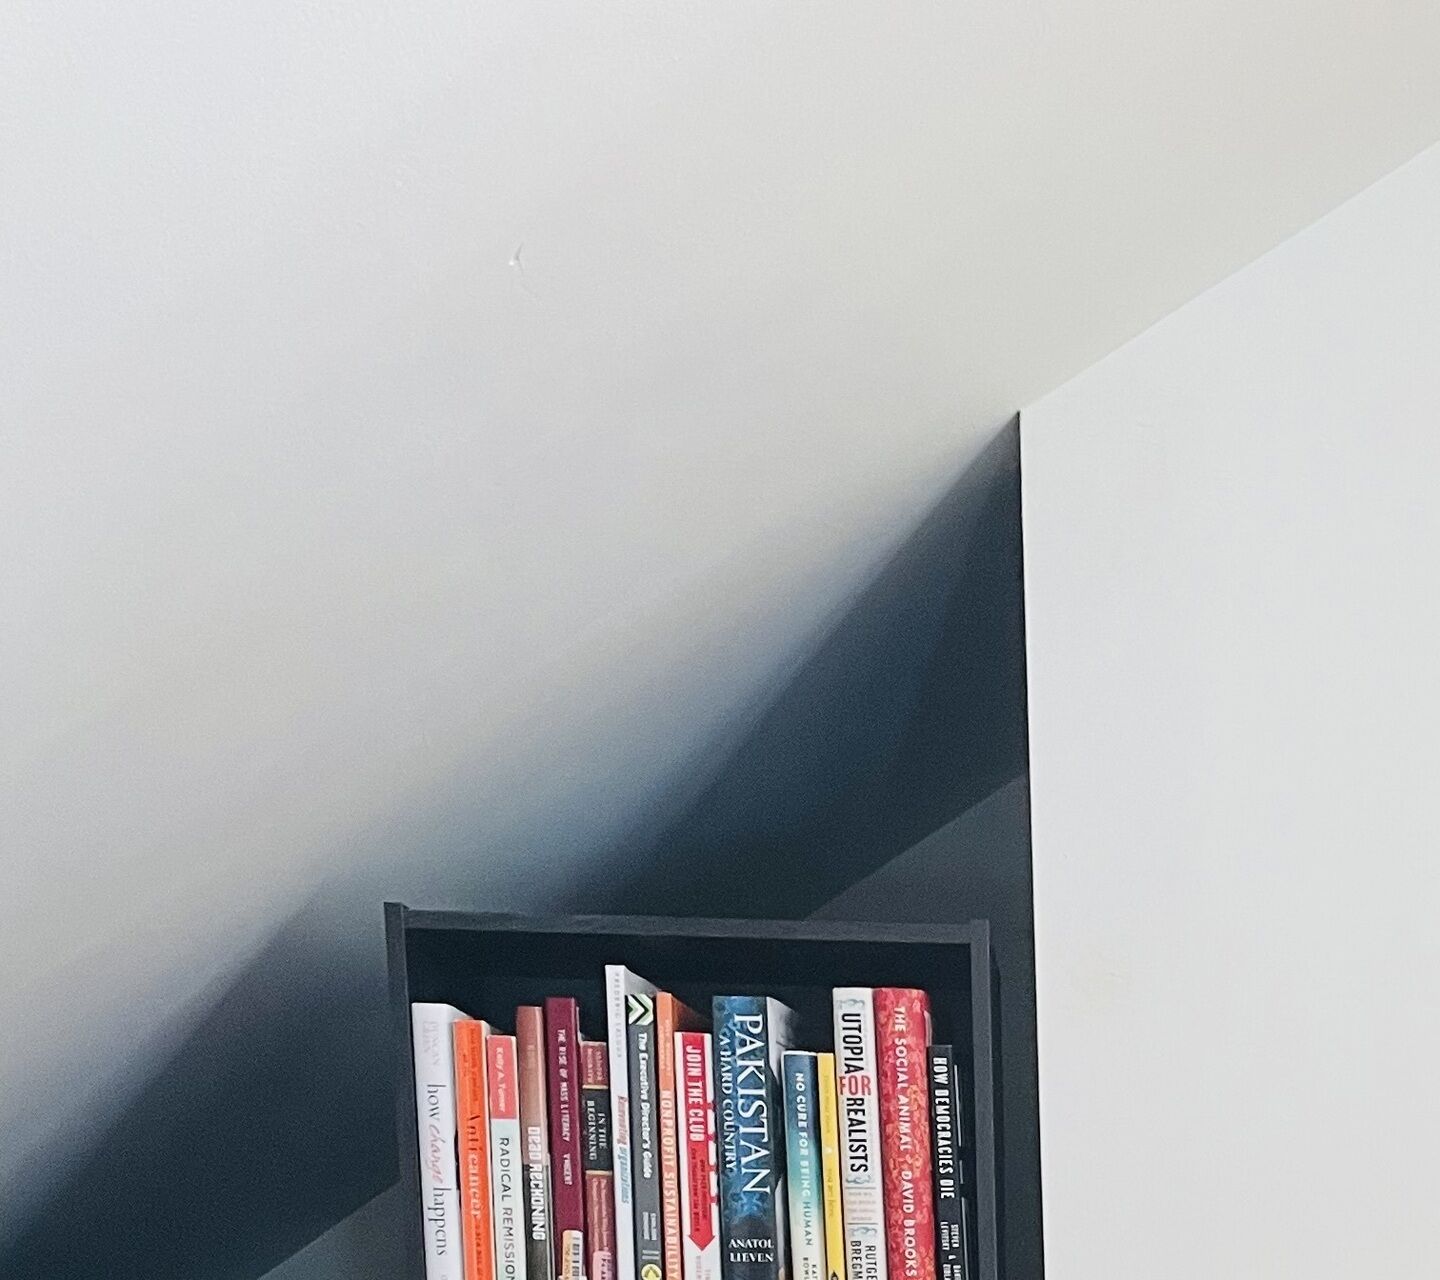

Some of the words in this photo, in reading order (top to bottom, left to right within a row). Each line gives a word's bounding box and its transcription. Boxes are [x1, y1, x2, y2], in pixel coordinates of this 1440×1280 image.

[558, 1029, 567, 1043] THE
[894, 1006, 907, 1031] THE
[558, 1047, 568, 1065] RISE
[638, 1033, 648, 1050] The
[720, 1035, 730, 1046] A
[841, 1012, 865, 1074] UTOPIA
[559, 1068, 568, 1078] OF
[638, 1053, 650, 1099] Executive
[686, 1045, 702, 1076] JOIN
[721, 1048, 733, 1095] HARD
[895, 1037, 910, 1089] SOCIAL
[932, 1057, 948, 1083] HOW
[560, 1081, 569, 1101] MASS
[688, 1080, 703, 1104] THE
[795, 1073, 805, 1091] NO
[839, 1074, 871, 1096] FOR
[425, 1083, 447, 1121] how
[598, 1113, 607, 1124] IN
[734, 1013, 770, 1195] PAKISTAN
[796, 1095, 807, 1128] CURE
[561, 1105, 570, 1142] LITERACY
[587, 1101, 598, 1160] BEGINNING
[598, 1128, 608, 1149] THE
[641, 1102, 652, 1149] Director's
[661, 1090, 678, 1167] NONPROFIT
[689, 1109, 704, 1141] CLUB
[722, 1098, 736, 1171] COUNTRY
[846, 1097, 868, 1173] REALISTS
[898, 1094, 913, 1151] ANIMAL
[934, 1089, 952, 1174] DEMOCRACIES
[422, 1124, 446, 1184] change
[798, 1132, 809, 1155] FOR
[499, 1137, 513, 1202] RADICAL
[642, 1151, 653, 1178] Guide
[800, 1160, 811, 1197] BEING
[901, 1170, 915, 1213] DAVID
[939, 1179, 954, 1198] DIE
[427, 1187, 451, 1256] happens
[662, 1172, 679, 1280] SUSTAINABILITY
[802, 1201, 814, 1246] HUMAN
[729, 1238, 774, 1249] ANATOL
[729, 1252, 774, 1263] LIEVEN
[903, 1219, 918, 1277] BROOKS
